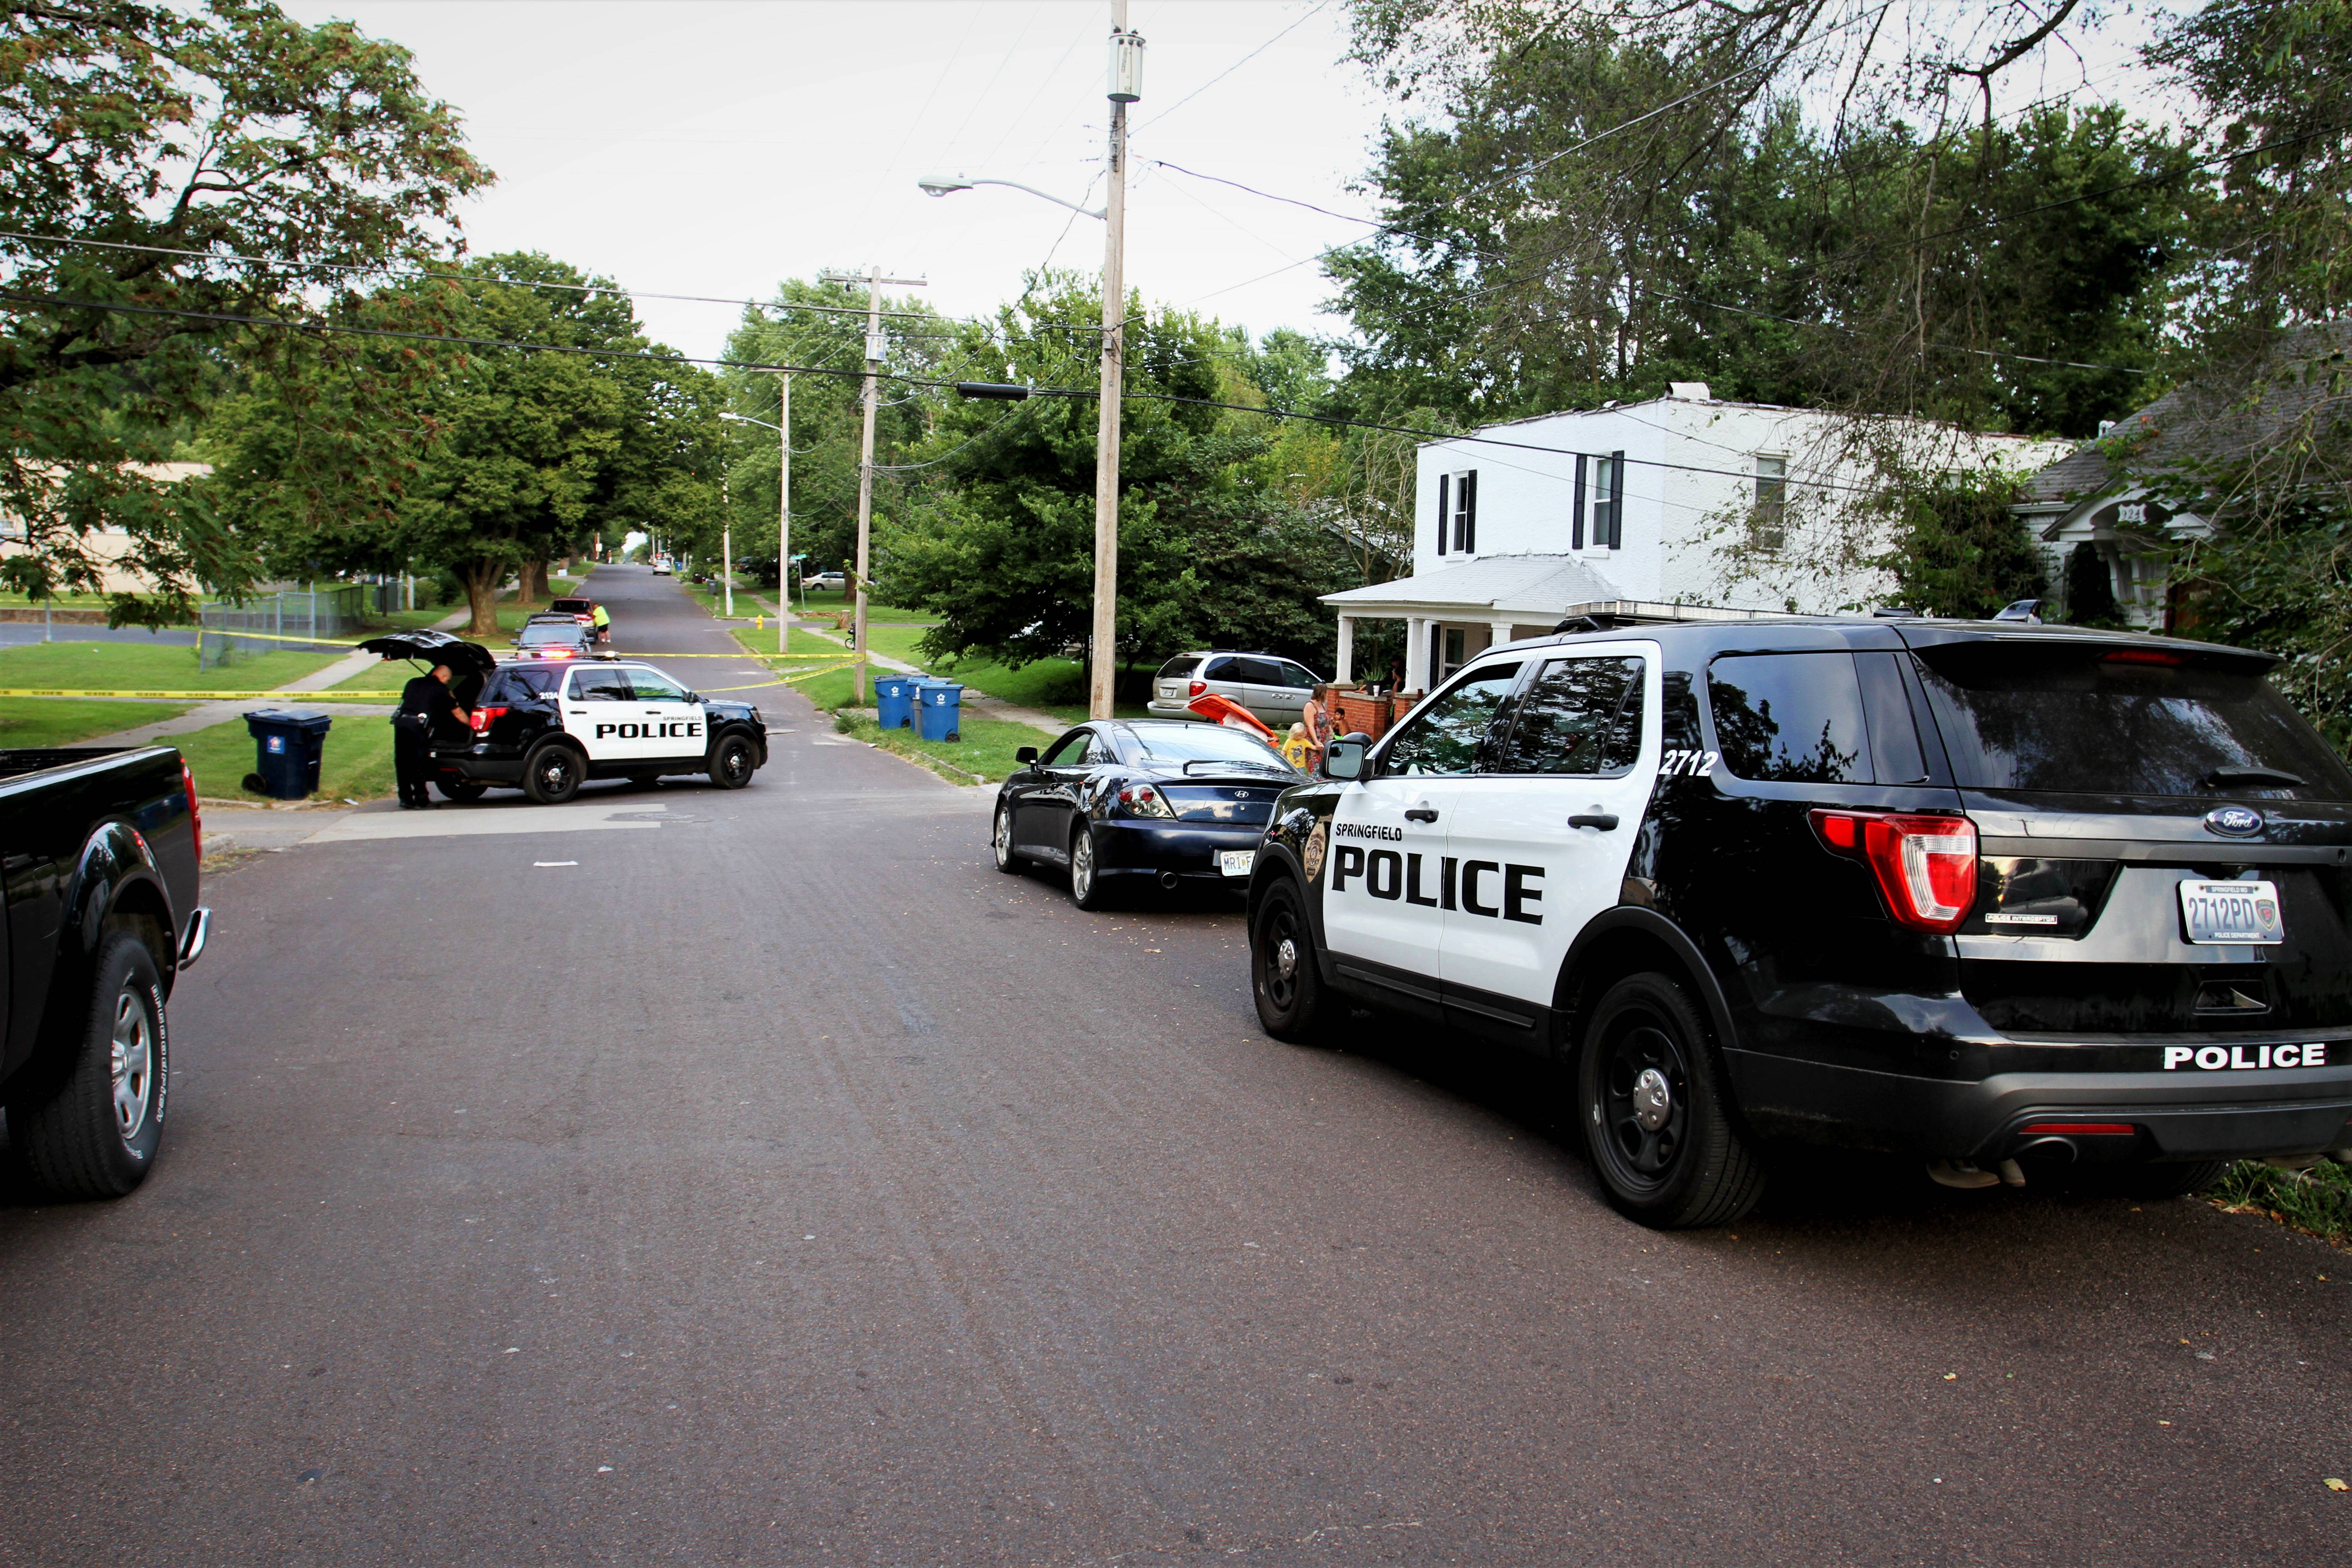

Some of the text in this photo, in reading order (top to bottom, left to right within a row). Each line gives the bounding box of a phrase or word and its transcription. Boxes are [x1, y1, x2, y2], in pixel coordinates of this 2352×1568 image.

[539, 691, 558, 700] 2124
[596, 723, 702, 739] POLICE
[1658, 749, 1719, 776] 2712
[2223, 811, 2253, 828] Ford
[1336, 823, 1402, 841] SPRINGFIELD
[1332, 845, 1545, 926] POLICE
[2188, 897, 2255, 929] 2712PD
[2164, 1044, 2325, 1069] POLICE
